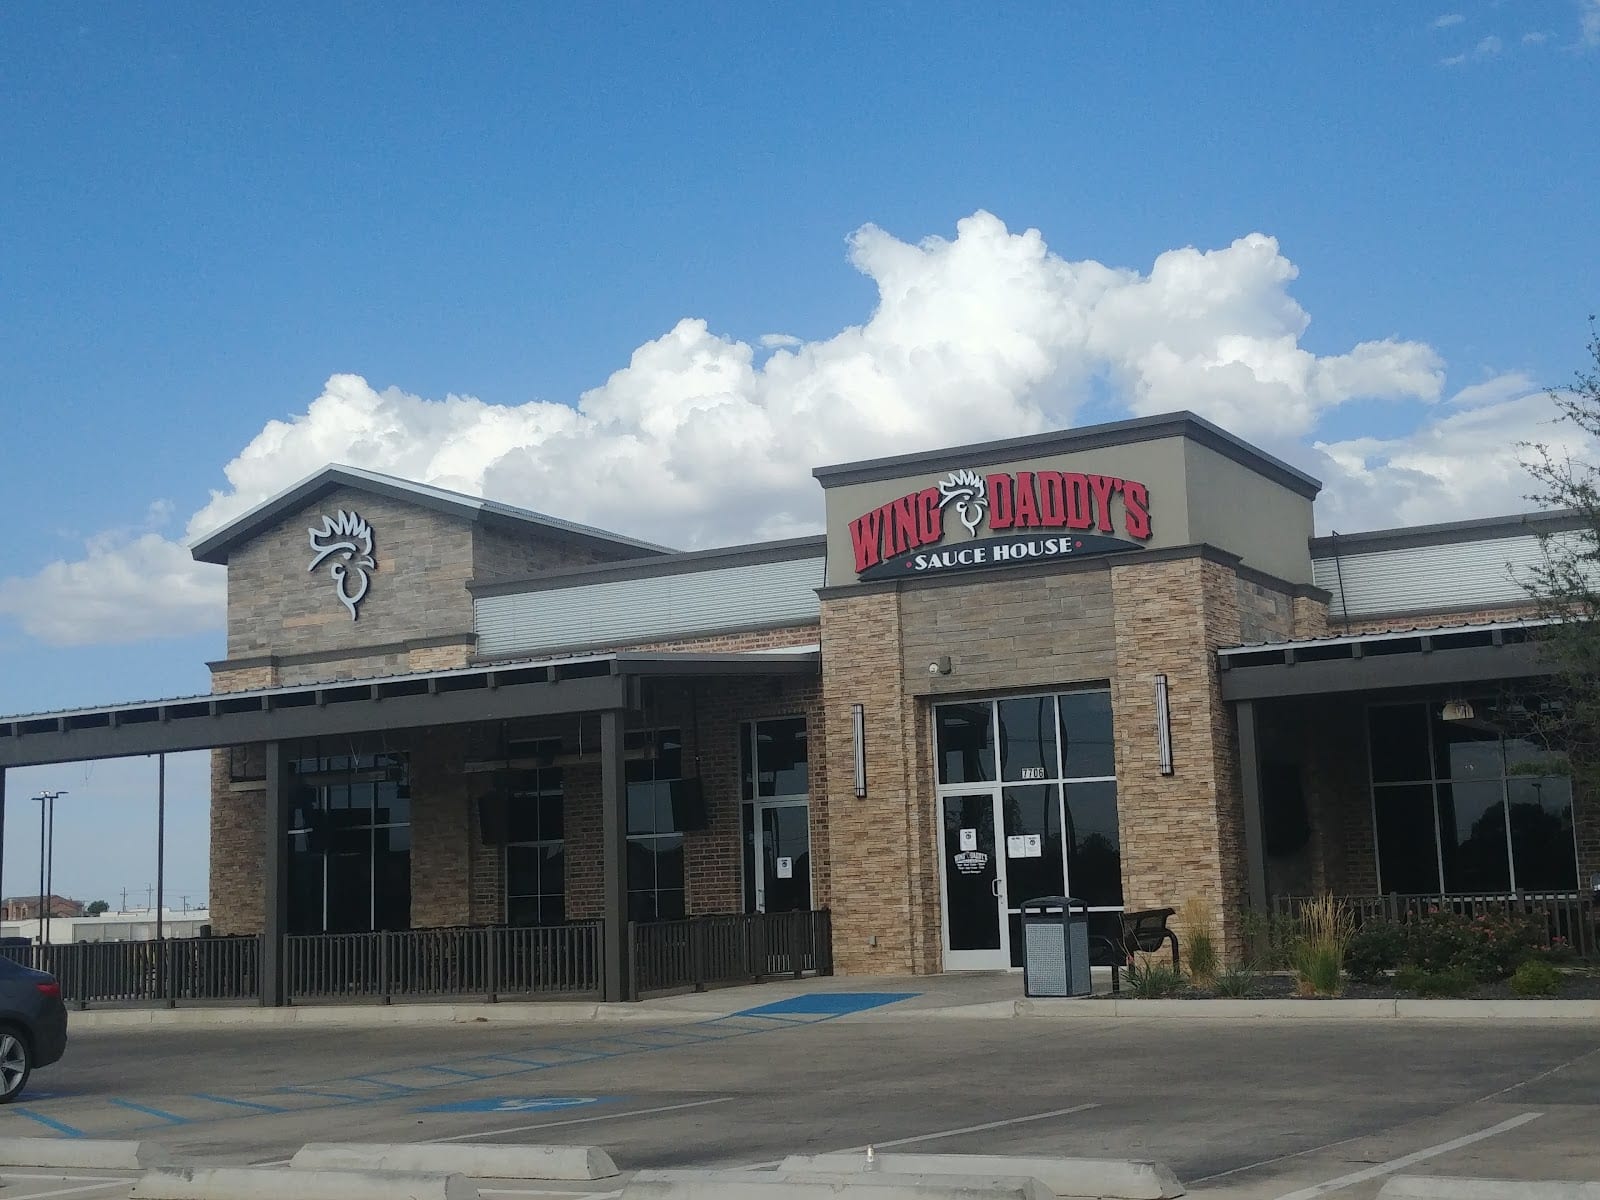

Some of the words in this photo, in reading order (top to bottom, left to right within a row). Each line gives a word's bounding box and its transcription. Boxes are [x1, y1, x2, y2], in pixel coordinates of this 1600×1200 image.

[848, 487, 942, 573] WING
[986, 471, 1152, 539] DADDY'S
[914, 548, 986, 570] SAUCE
[993, 537, 1072, 561] HOUSE
[1022, 768, 1043, 778] 7706
